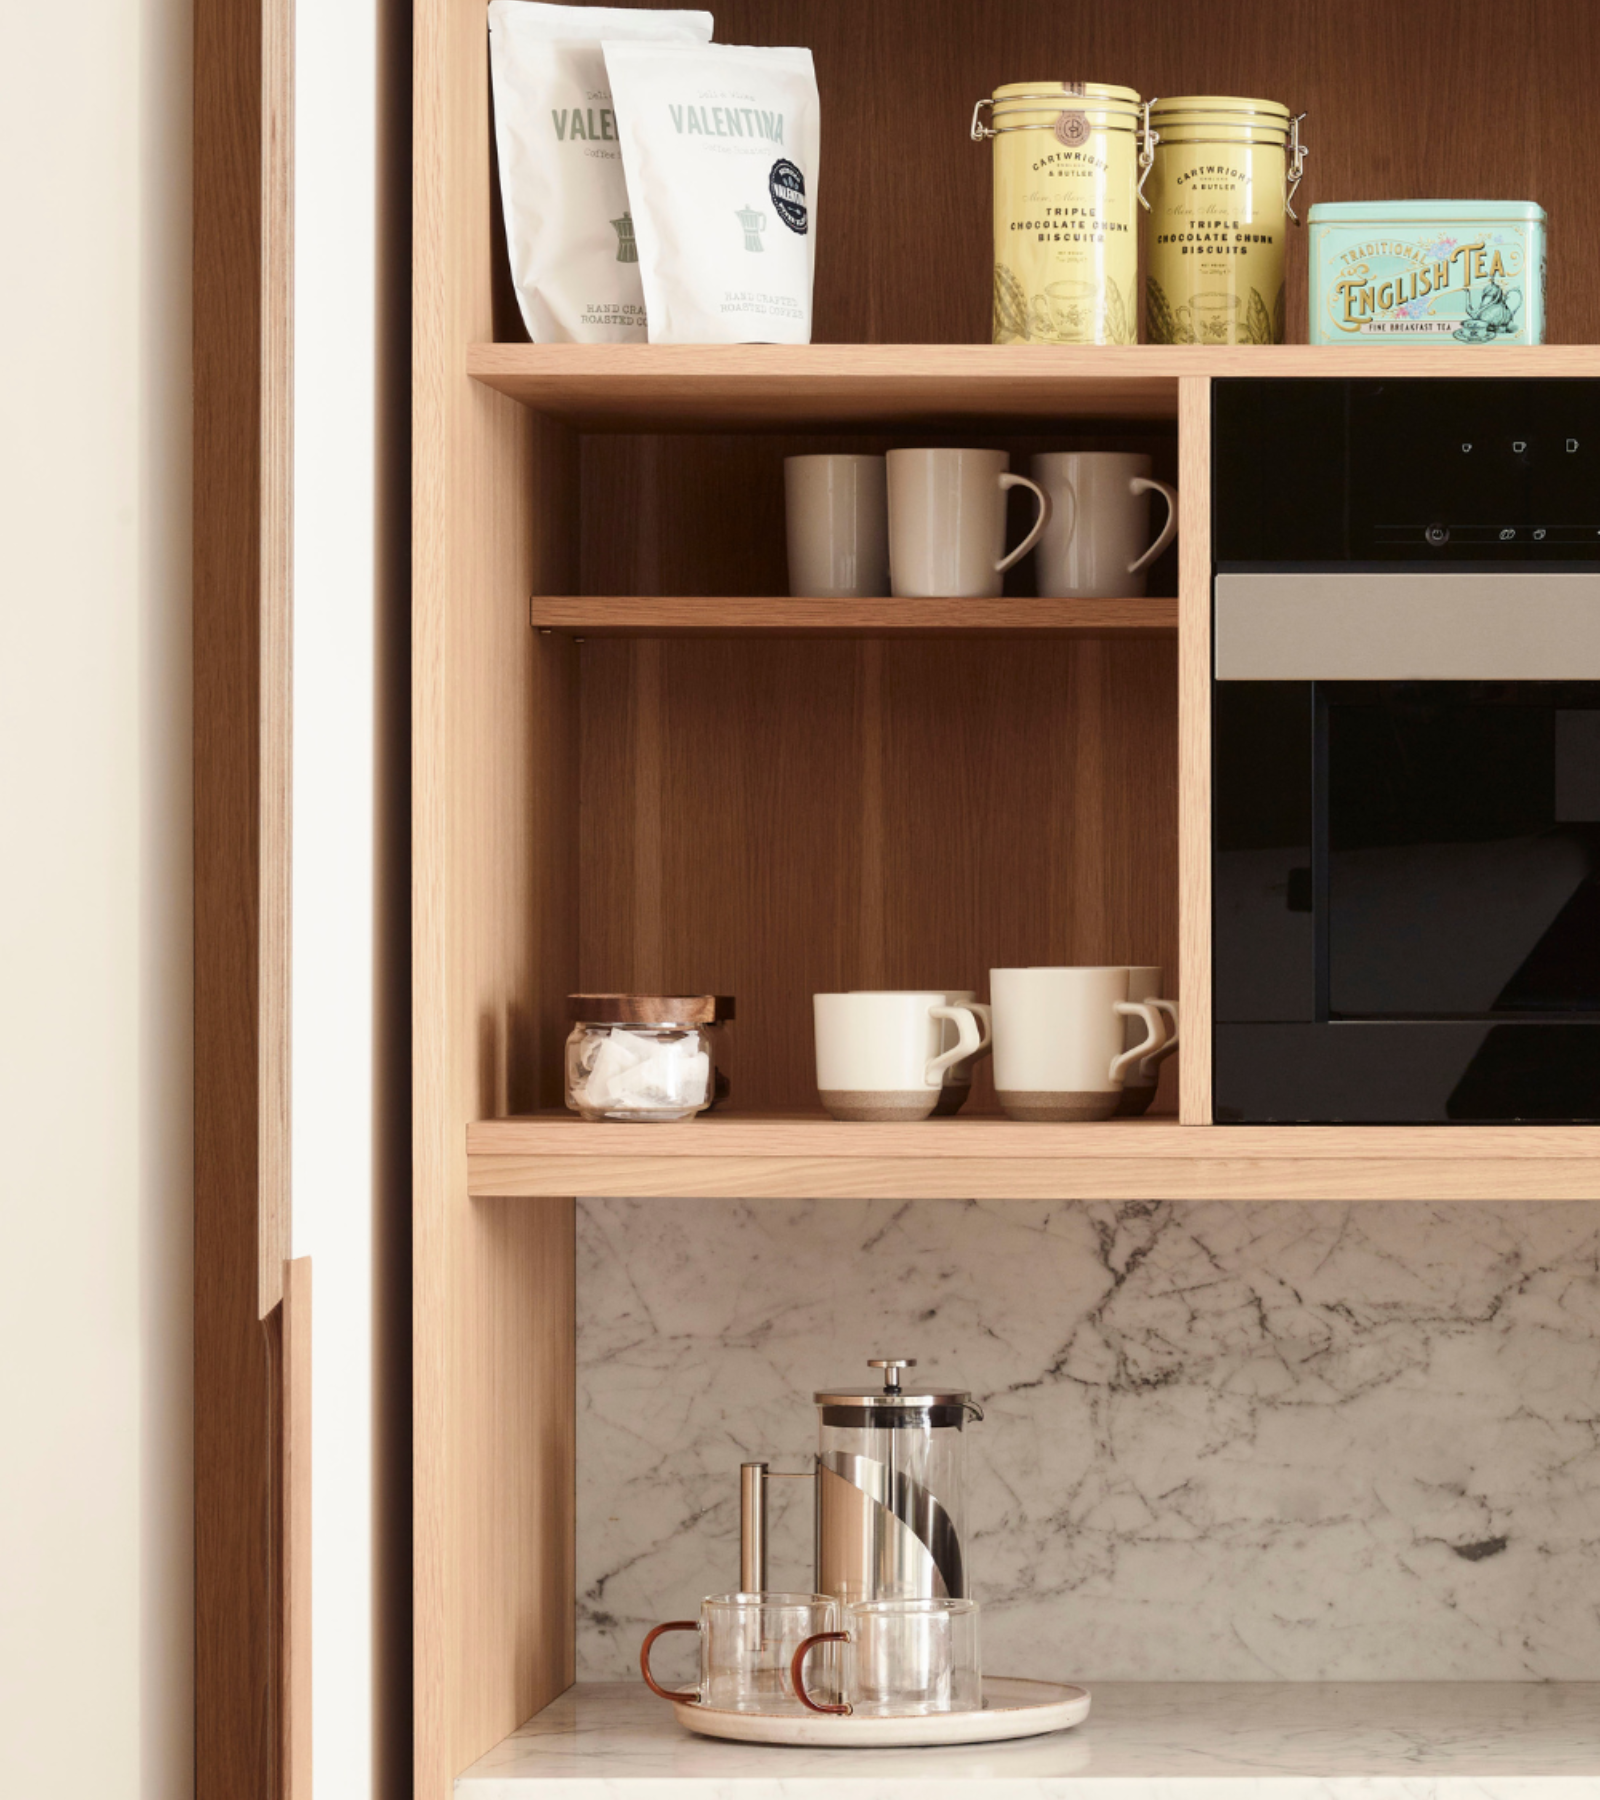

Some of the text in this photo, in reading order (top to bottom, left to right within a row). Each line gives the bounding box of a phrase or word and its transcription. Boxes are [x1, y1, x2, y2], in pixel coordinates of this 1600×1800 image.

[668, 103, 785, 146] VALENTINA
[1032, 151, 1109, 172] CARTWRIGHT
[1176, 166, 1252, 185] CARTWRIGHT
[1046, 208, 1096, 217] TRIPLE
[1010, 221, 1129, 233] CHOCOLATE CHUNK
[1190, 221, 1239, 230] TRIPLE
[1037, 233, 1104, 242] BISCUITS
[1157, 233, 1273, 244] CHOCOLATE CHUNK
[1181, 246, 1247, 255] BISCUITS
[1340, 242, 1427, 265] TRADITIONAL
[1335, 259, 1449, 324] ENGLISH
[1450, 241, 1506, 288] TEA
[724, 291, 798, 308] HAND CRAFTED
[586, 303, 647, 315] HAND CRA
[720, 302, 804, 320] ROASTED COFFEE
[580, 314, 635, 326] ROASTED
[1369, 323, 1451, 332] FINE BREAKFAST TEA
